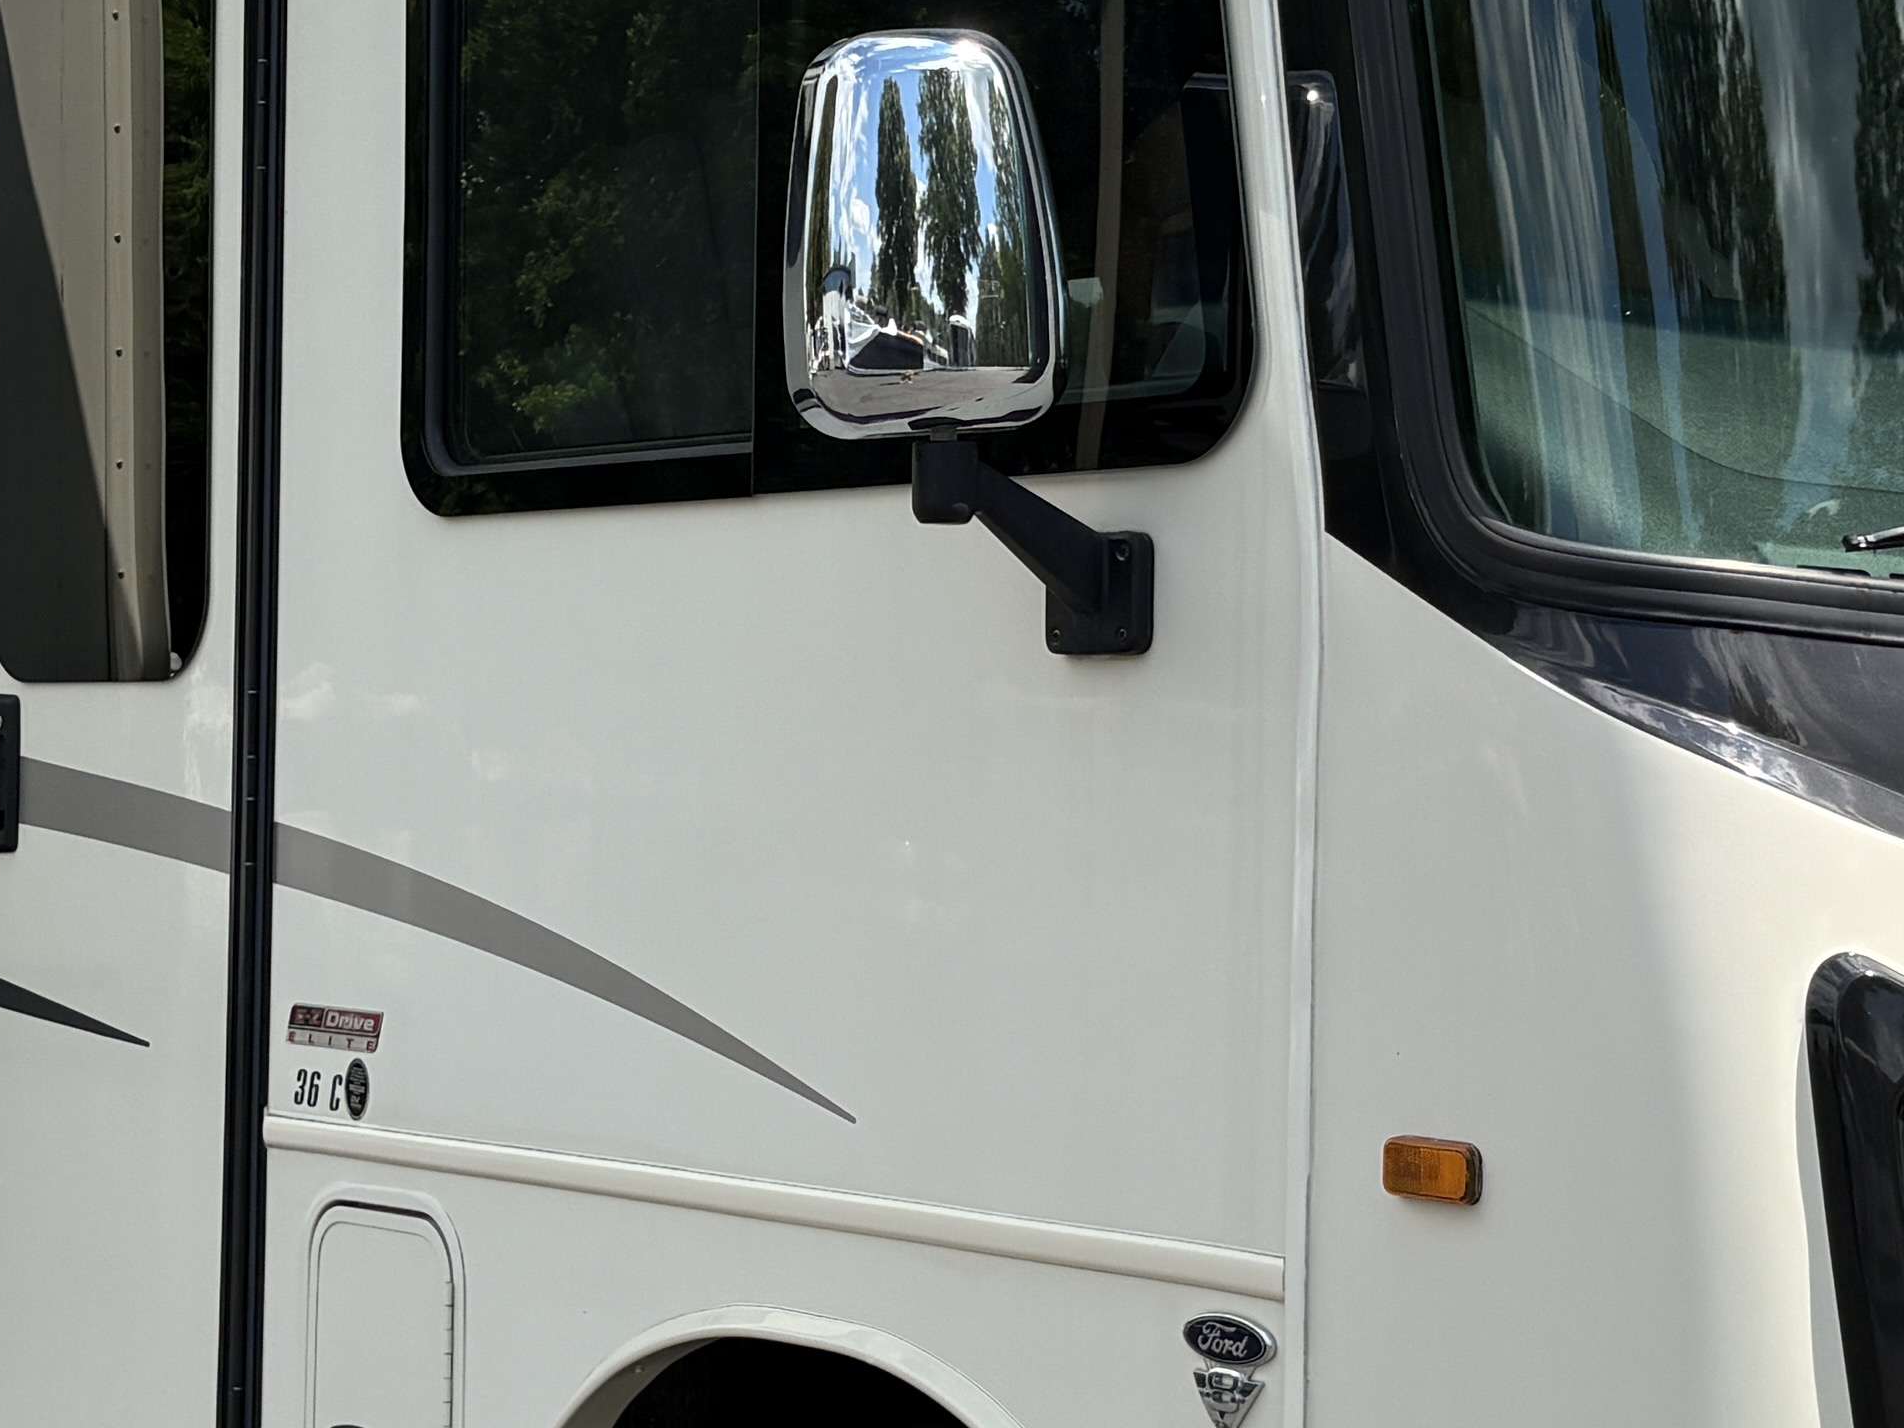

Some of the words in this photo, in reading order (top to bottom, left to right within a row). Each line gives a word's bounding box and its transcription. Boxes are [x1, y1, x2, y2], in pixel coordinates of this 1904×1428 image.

[325, 1011, 375, 1031] Drive
[287, 1031, 376, 1051] ELITE
[293, 1068, 322, 1108] 36
[328, 1073, 344, 1112] C
[1196, 1321, 1249, 1359] Ford
